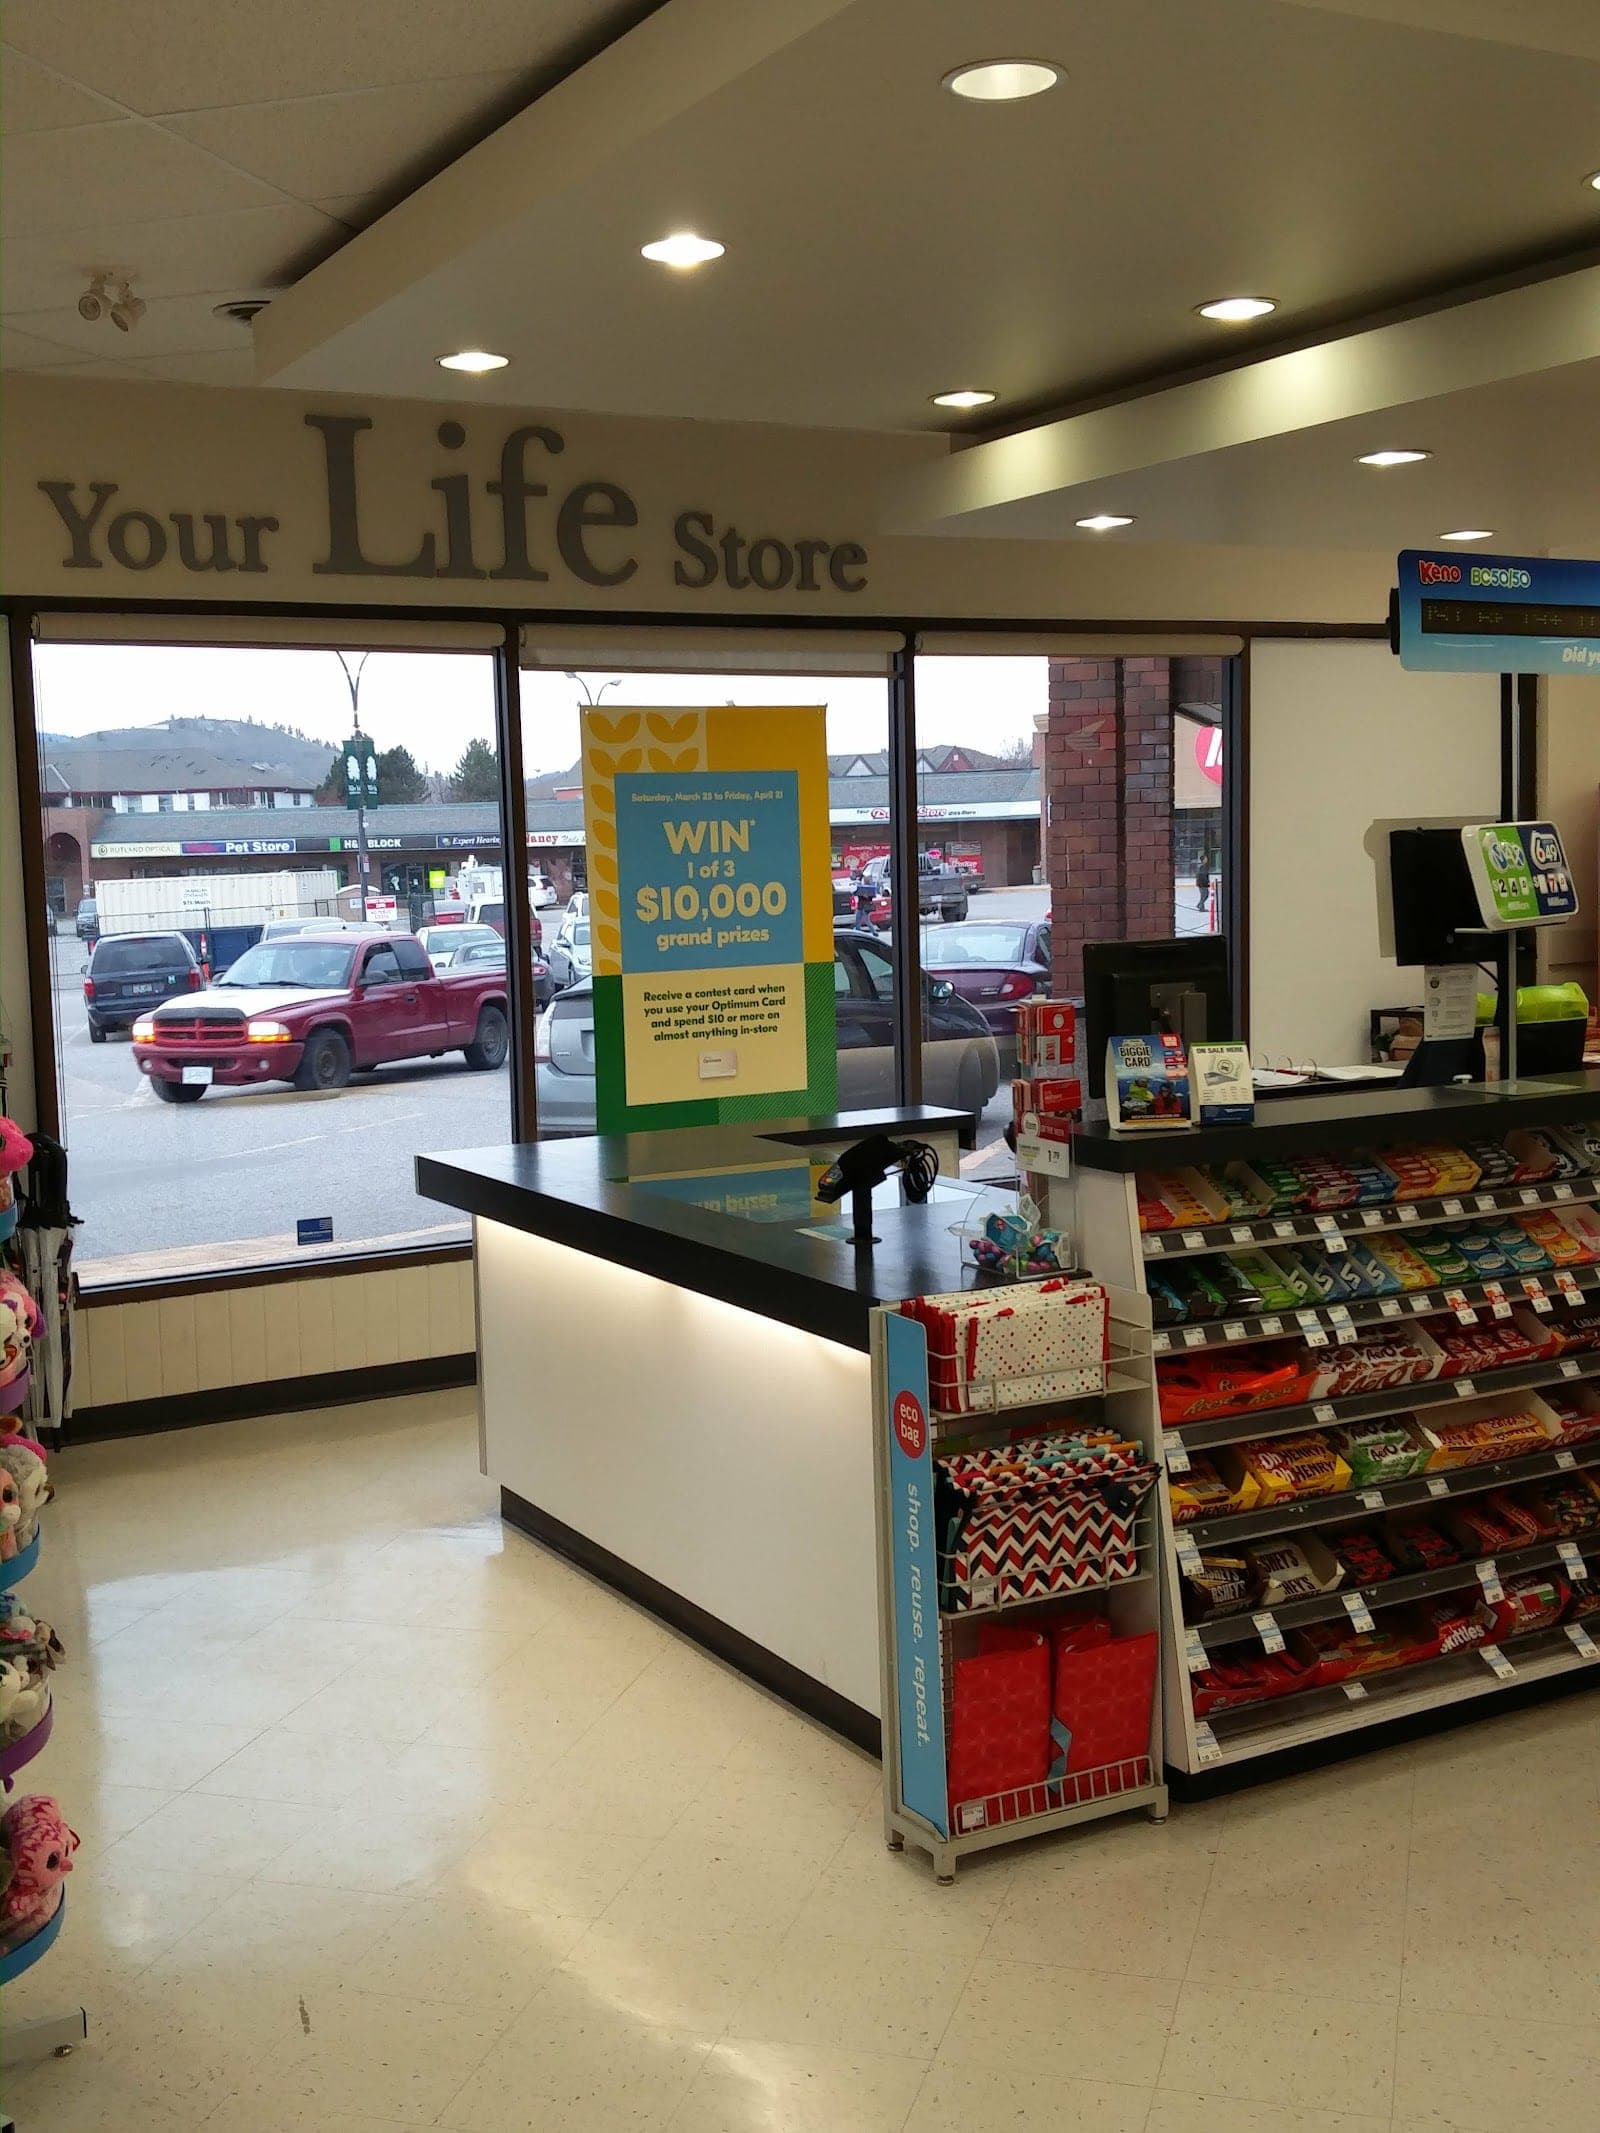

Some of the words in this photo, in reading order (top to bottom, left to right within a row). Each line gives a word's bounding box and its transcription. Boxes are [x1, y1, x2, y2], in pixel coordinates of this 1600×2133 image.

[37, 482, 280, 574] Your
[304, 414, 640, 588] Life
[673, 512, 869, 591] Store
[1419, 560, 1462, 585] Keno
[1470, 567, 1532, 589] BC50/50
[1562, 646, 1588, 663] Did
[631, 793, 673, 803] Saturday,
[675, 792, 701, 801] March
[714, 791, 723, 800] to
[724, 790, 752, 802] Friday,
[754, 789, 774, 800] April
[916, 806, 947, 818] Store
[225, 841, 249, 853] Pet
[252, 840, 291, 852] Store
[367, 838, 402, 848] BLOCK
[453, 836, 475, 847] Expert
[700, 860, 720, 878] of
[724, 860, 736, 877] 3
[636, 881, 788, 925] $10,000
[656, 926, 713, 951] grand
[717, 924, 770, 948] prizes
[643, 990, 683, 1002] Receive
[685, 991, 693, 999] a
[695, 987, 732, 999] contest
[734, 984, 756, 996] card
[757, 983, 786, 994] when
[643, 1005, 663, 1018] you
[666, 1005, 684, 1014] use
[686, 1003, 710, 1015] your
[711, 999, 760, 1012] Optimum
[761, 996, 786, 1007] Card
[651, 1017, 671, 1029] and
[674, 1014, 705, 1029] spend
[707, 1013, 725, 1025] $10
[727, 1014, 737, 1023] or
[740, 1012, 765, 1022] more
[767, 1010, 780, 1020] on
[654, 1030, 689, 1042] almost
[691, 1026, 738, 1041] anything
[740, 1024, 779, 1036] in-store
[1119, 1046, 1152, 1057] BIGGIE
[1124, 1056, 1152, 1068] CARD
[900, 1403, 919, 1423] eco
[900, 1418, 921, 1448] bag
[1258, 1452, 1283, 1470] Oh
[906, 1482, 922, 1553] shop.
[910, 1564, 923, 1644] reuse.
[912, 1655, 931, 1748] repeat.
